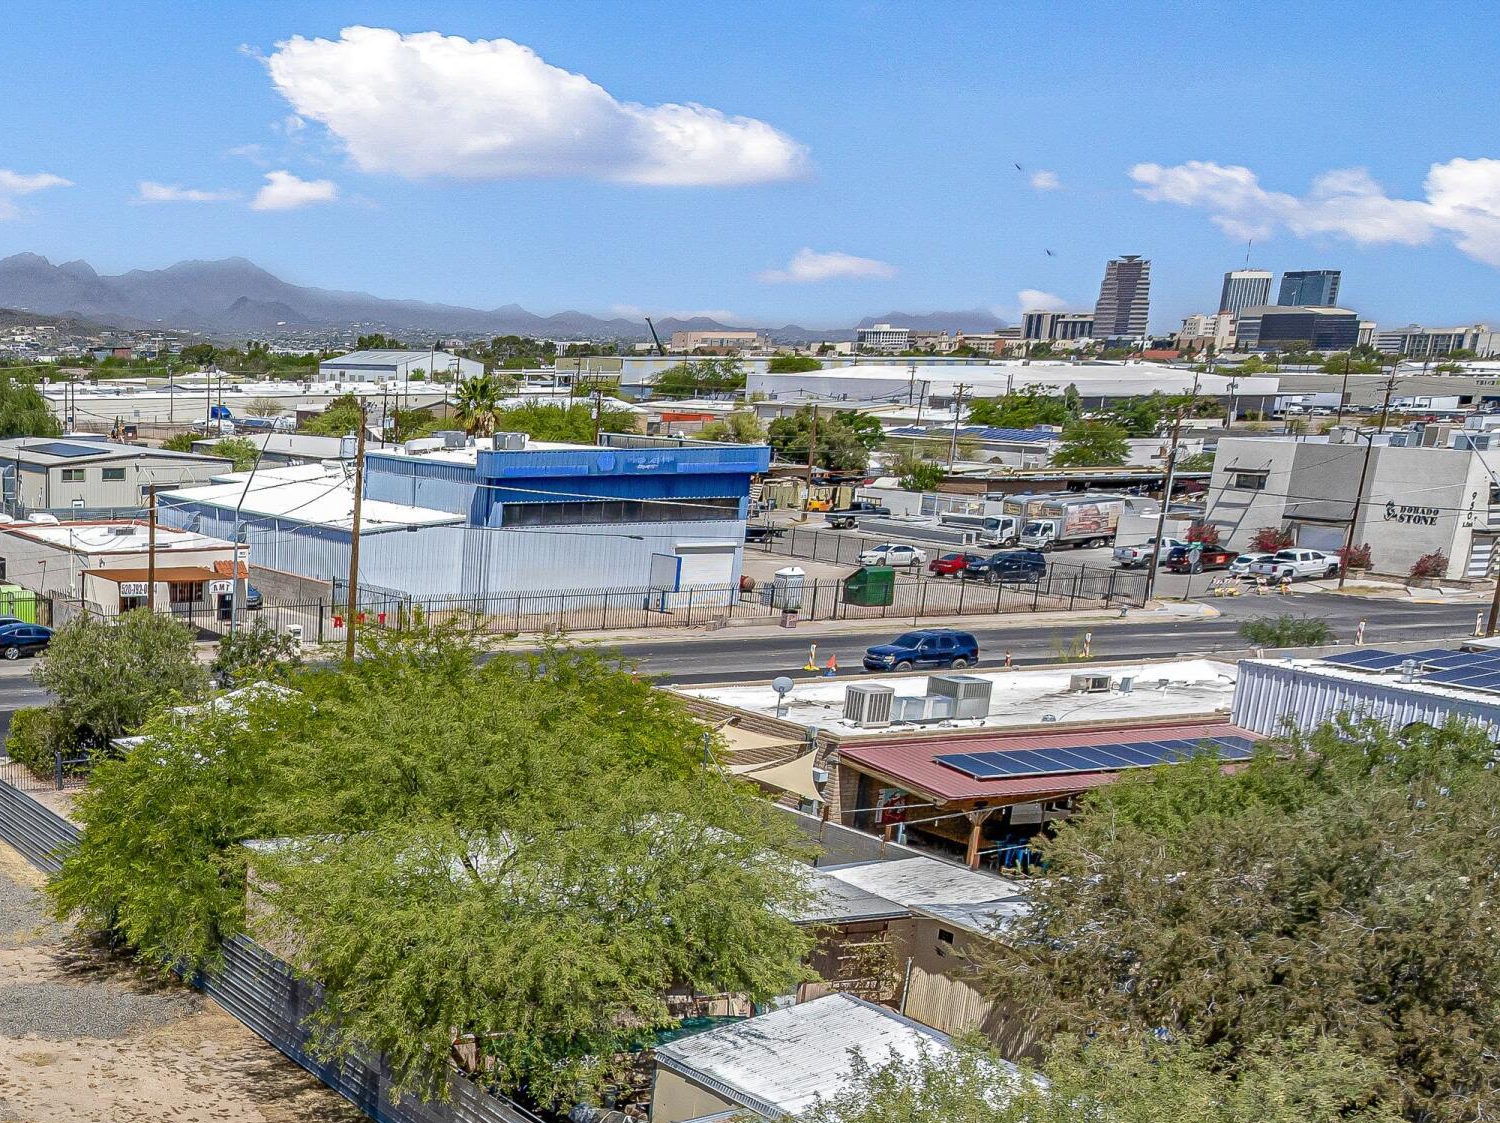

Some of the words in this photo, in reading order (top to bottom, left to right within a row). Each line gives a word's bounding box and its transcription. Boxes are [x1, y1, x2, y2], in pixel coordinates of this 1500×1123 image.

[1400, 505, 1439, 516] DORADO
[1397, 514, 1438, 526] STONE
[213, 584, 230, 592] AMT
